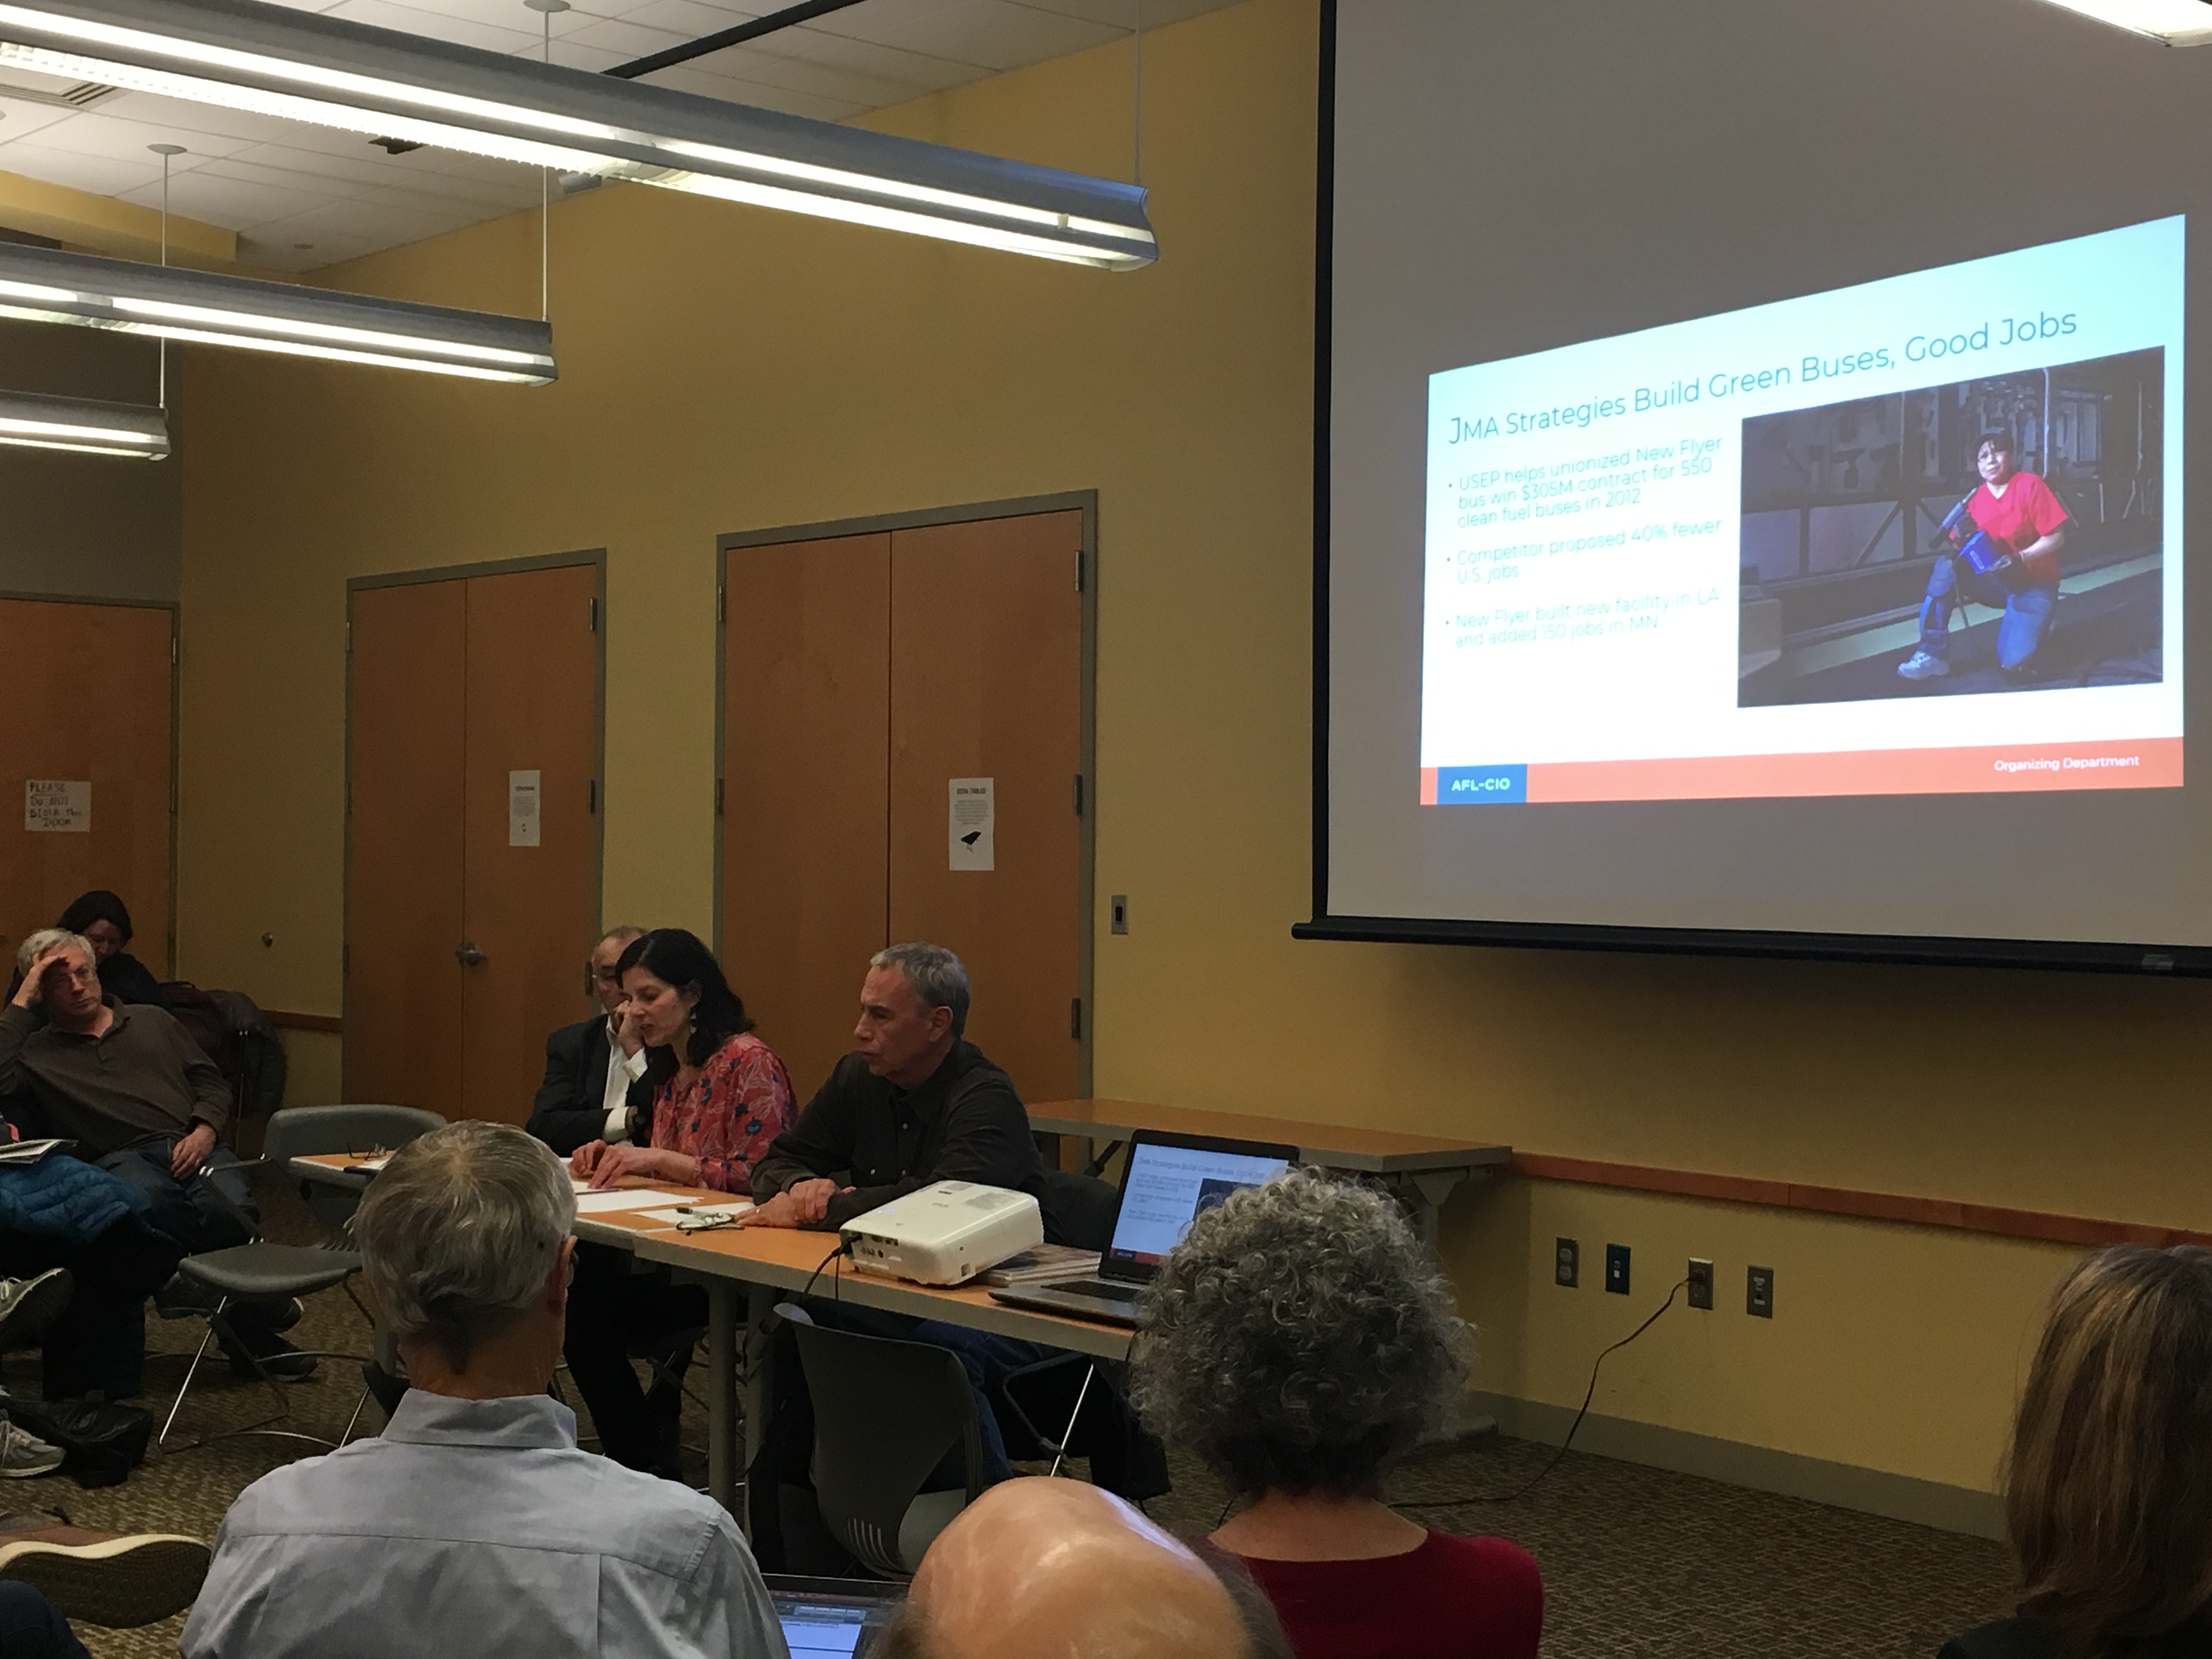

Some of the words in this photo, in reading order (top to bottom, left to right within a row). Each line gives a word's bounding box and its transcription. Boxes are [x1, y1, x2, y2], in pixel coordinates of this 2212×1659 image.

[1449, 416, 1499, 444] JMA
[1506, 396, 1626, 435] Strategies
[1635, 377, 1700, 411] Build
[1709, 364, 1790, 398] Green
[1803, 347, 1895, 382] Buses,
[1906, 322, 1989, 362] Good
[2000, 312, 2078, 346] Jobs
[1459, 493, 1485, 509] bus
[1491, 489, 1516, 504] win
[1522, 479, 1573, 501] $305M
[1578, 467, 1646, 492] contract
[1653, 462, 1675, 479] for
[1681, 456, 1712, 476] 550
[1460, 470, 1499, 491] USEP
[1505, 464, 1545, 484] helps
[1550, 449, 1630, 477] unionized
[1636, 445, 1674, 462] New
[1680, 437, 1723, 460] Flyer
[1458, 509, 1498, 528] clean
[1503, 503, 1531, 522] fuel
[1536, 498, 1581, 517] buses
[1586, 494, 1600, 510] in
[1606, 488, 1641, 508] 2012
[1457, 542, 1543, 566] Competitor
[1549, 529, 1626, 556] proposed
[1630, 524, 1668, 543] 40%
[1672, 518, 1722, 537] fewer
[1487, 563, 1519, 584] jobs
[1456, 611, 1489, 628] New
[1494, 607, 1531, 627] Flyer
[1536, 603, 1571, 622] built
[1576, 601, 1610, 616] new
[1616, 594, 1670, 613] facility
[1676, 589, 1690, 605] in
[1697, 588, 1719, 606] LA
[1455, 630, 1483, 648] and
[1489, 625, 1537, 645] added
[1542, 623, 1566, 640] 150
[1571, 619, 1604, 641] jobs
[1610, 617, 1624, 632] in
[1629, 615, 1658, 631] MN
[1994, 758, 2060, 772] Organizing
[2063, 755, 2140, 769] Department
[1451, 777, 1510, 791] AFL-CIO
